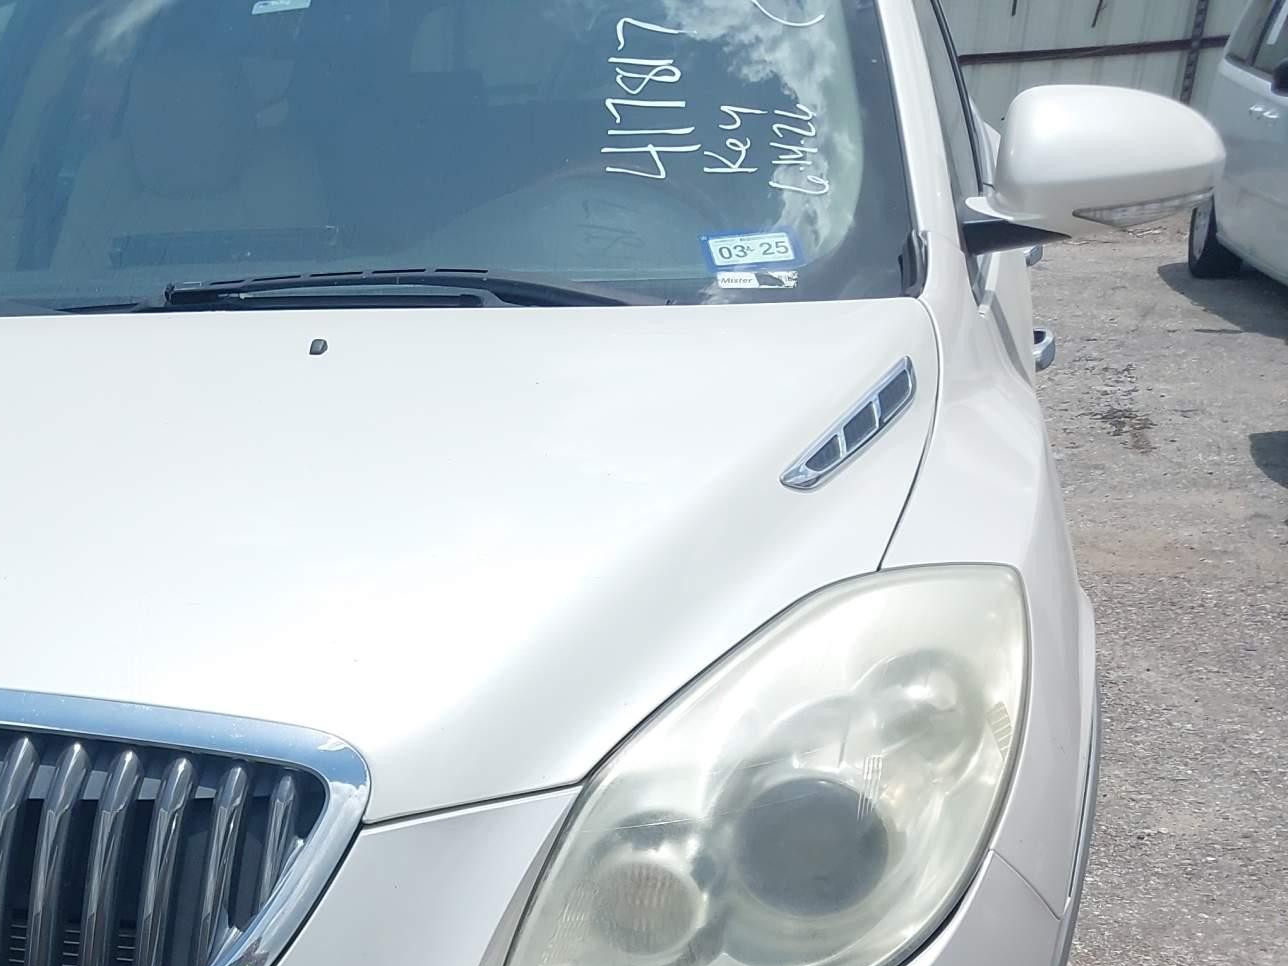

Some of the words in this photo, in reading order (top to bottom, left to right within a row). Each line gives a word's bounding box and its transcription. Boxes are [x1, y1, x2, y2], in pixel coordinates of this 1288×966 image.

[703, 105, 768, 173] Key
[718, 245, 748, 260] 03
[759, 241, 789, 256] 25
